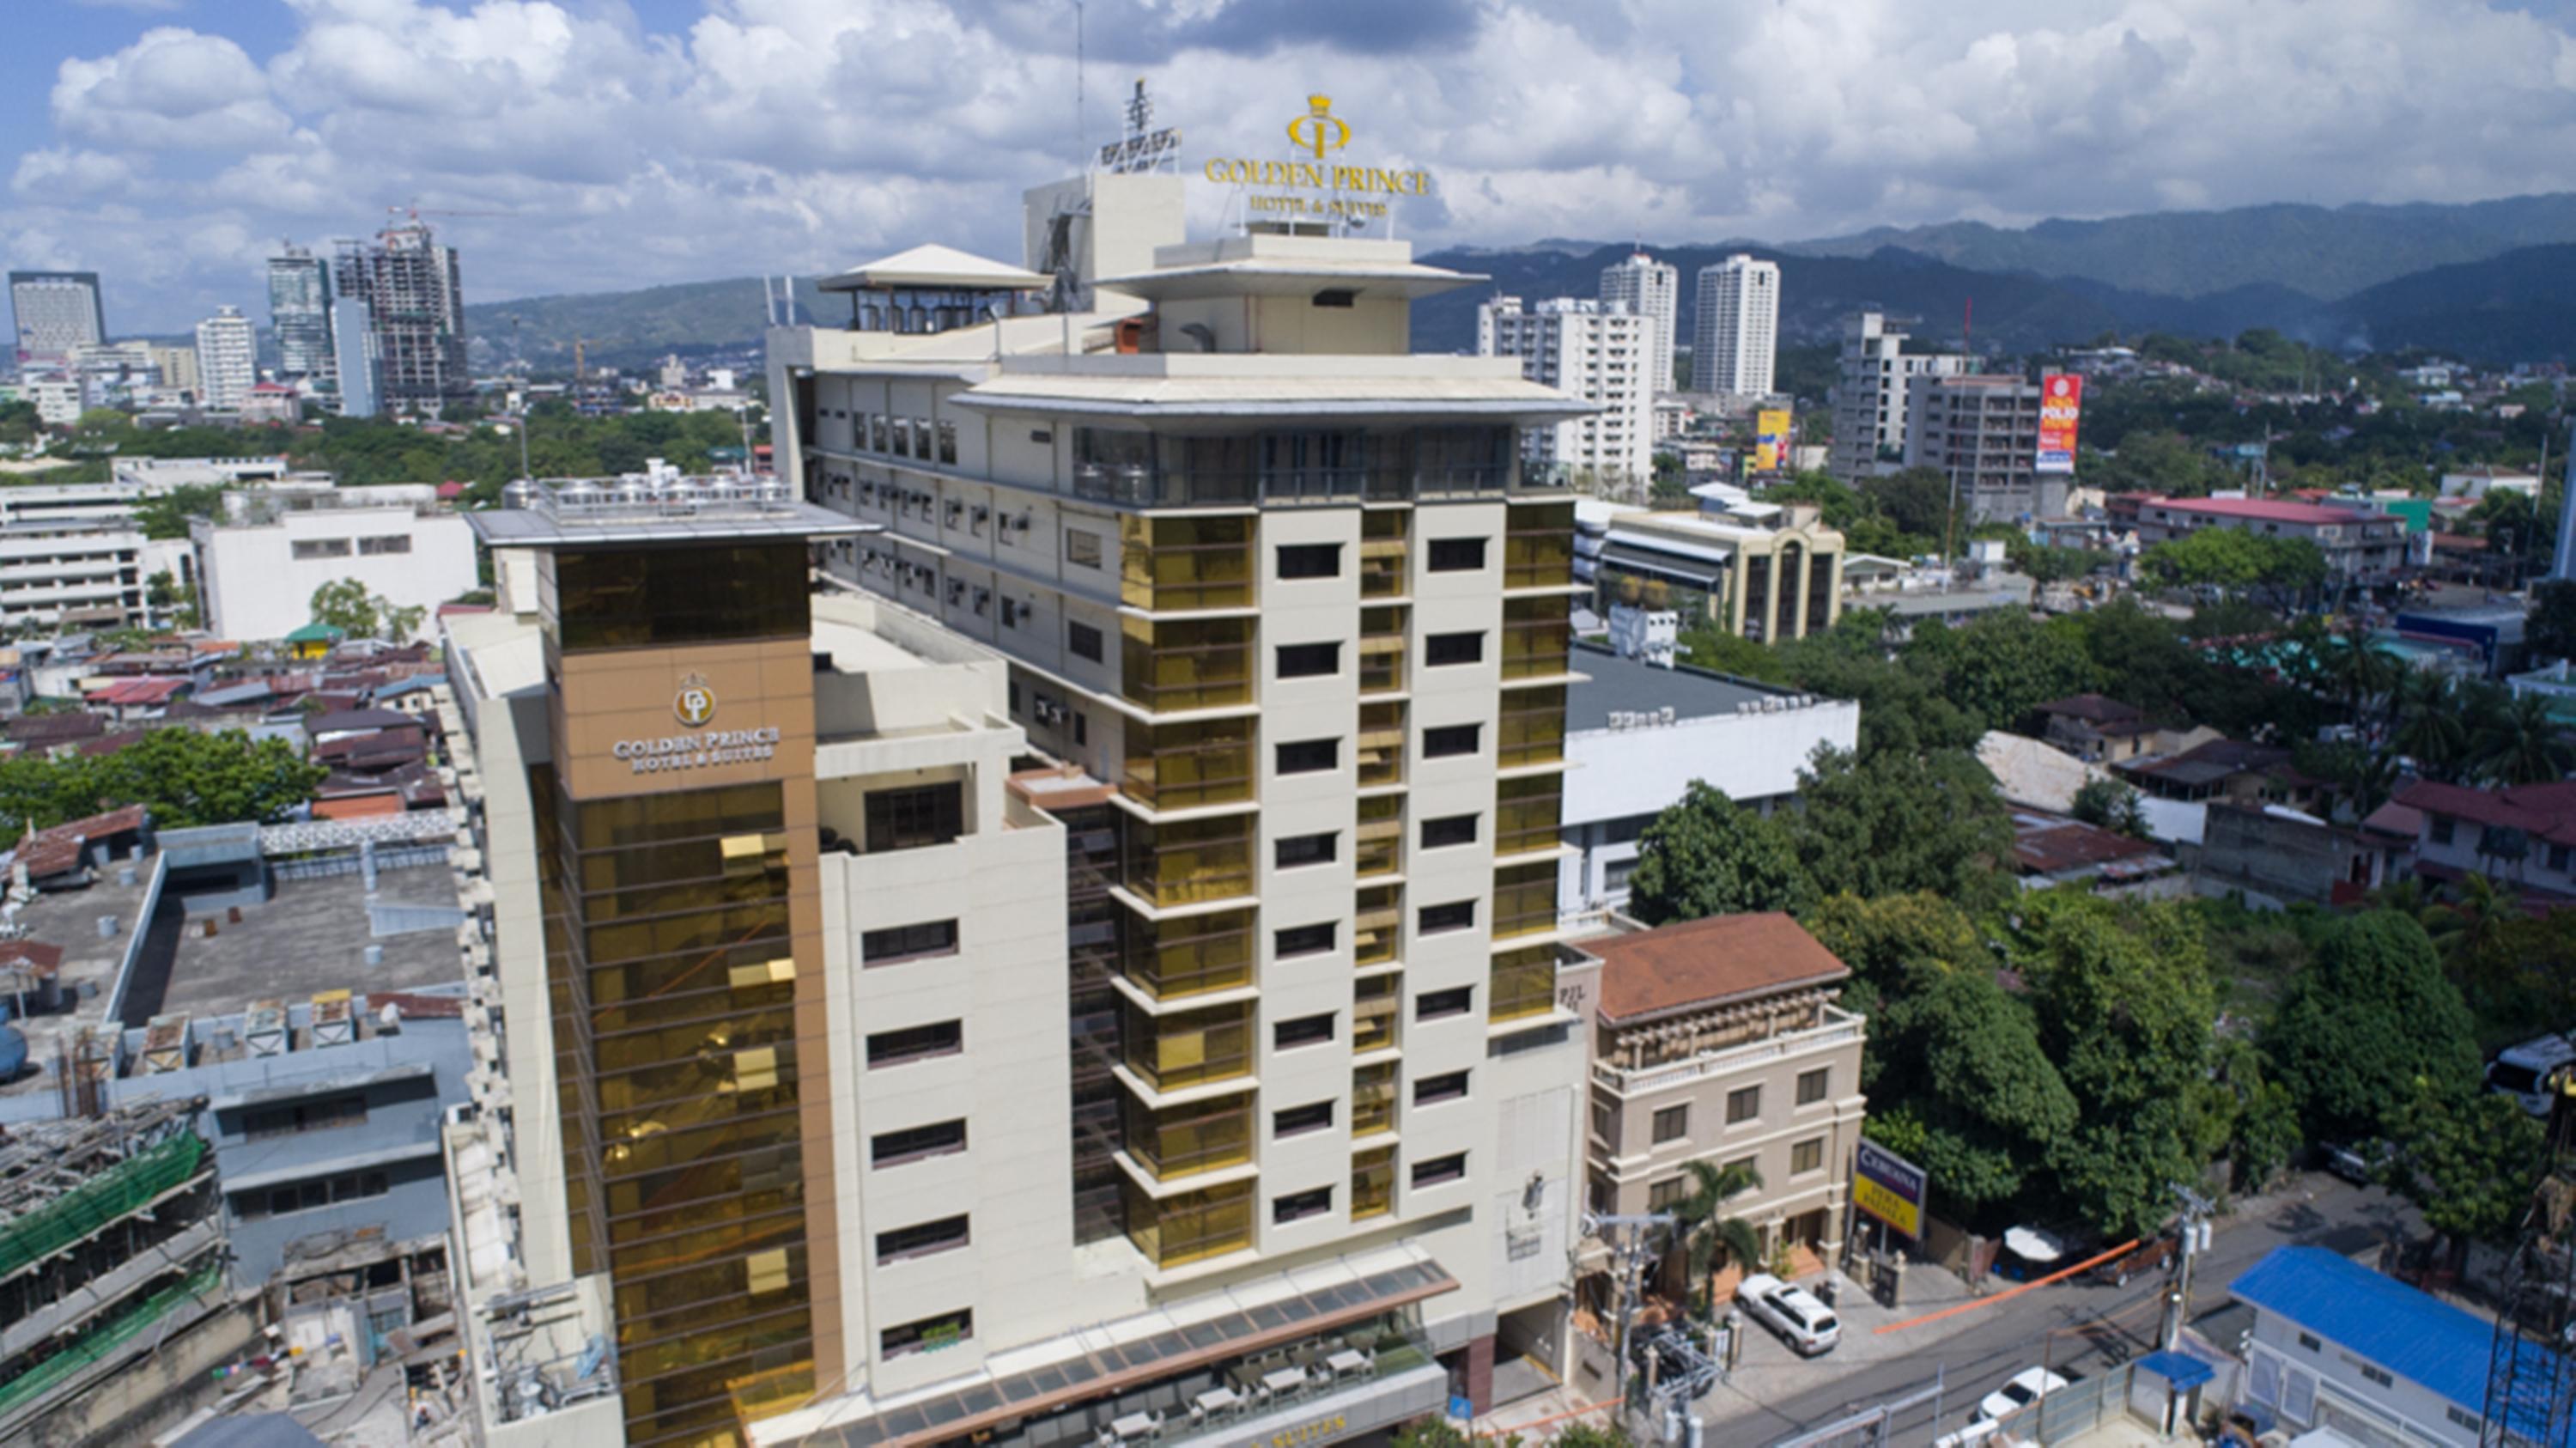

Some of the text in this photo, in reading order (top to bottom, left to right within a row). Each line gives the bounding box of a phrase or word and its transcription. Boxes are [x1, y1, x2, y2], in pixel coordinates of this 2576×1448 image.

[1205, 157, 1430, 195] GOLDEN PRINCE
[1249, 196, 1388, 216] HOTEL & SUITES
[613, 727, 781, 757] GOLDEN PRINCE
[632, 745, 775, 773] HOTEL & SUITES
